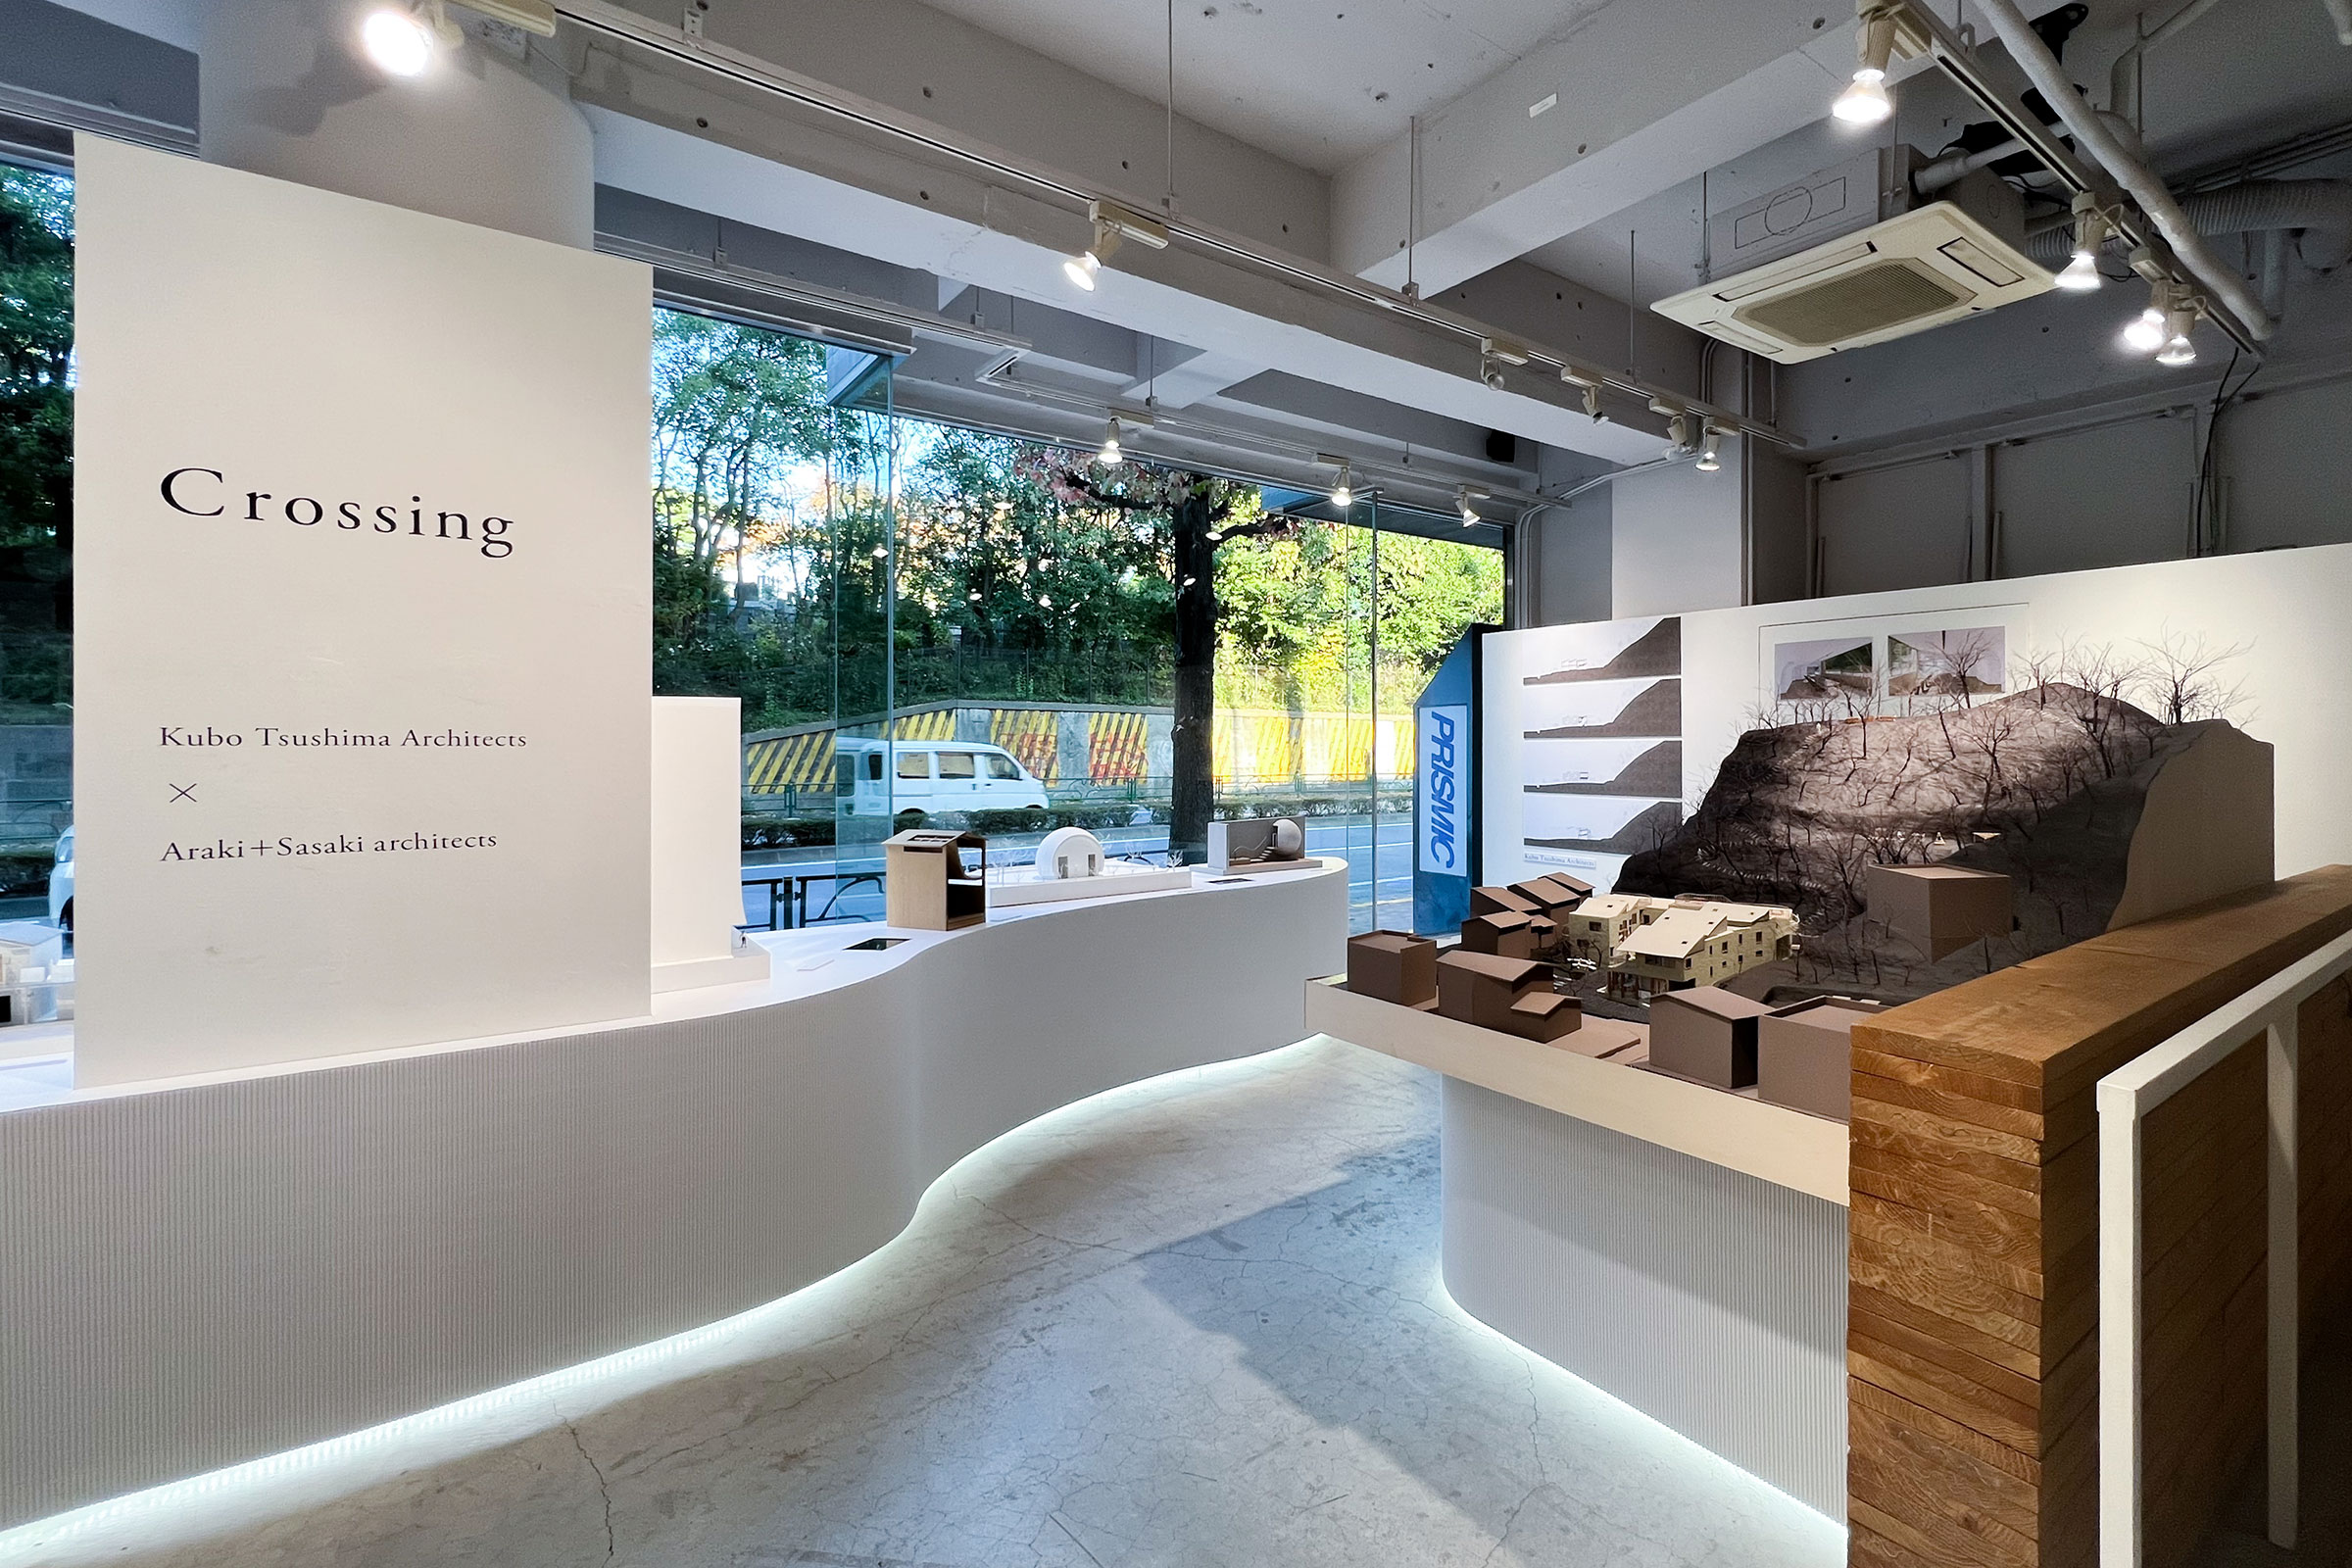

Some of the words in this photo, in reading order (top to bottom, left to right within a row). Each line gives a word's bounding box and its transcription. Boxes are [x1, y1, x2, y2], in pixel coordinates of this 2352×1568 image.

[160, 467, 514, 559] Crossing
[161, 726, 243, 747] Kubo
[255, 727, 391, 747] Tsushima
[401, 728, 526, 747] Architects
[1430, 710, 1455, 869] PRISMIC
[160, 834, 364, 862] Araki+Sasaki
[373, 831, 497, 853] architects
